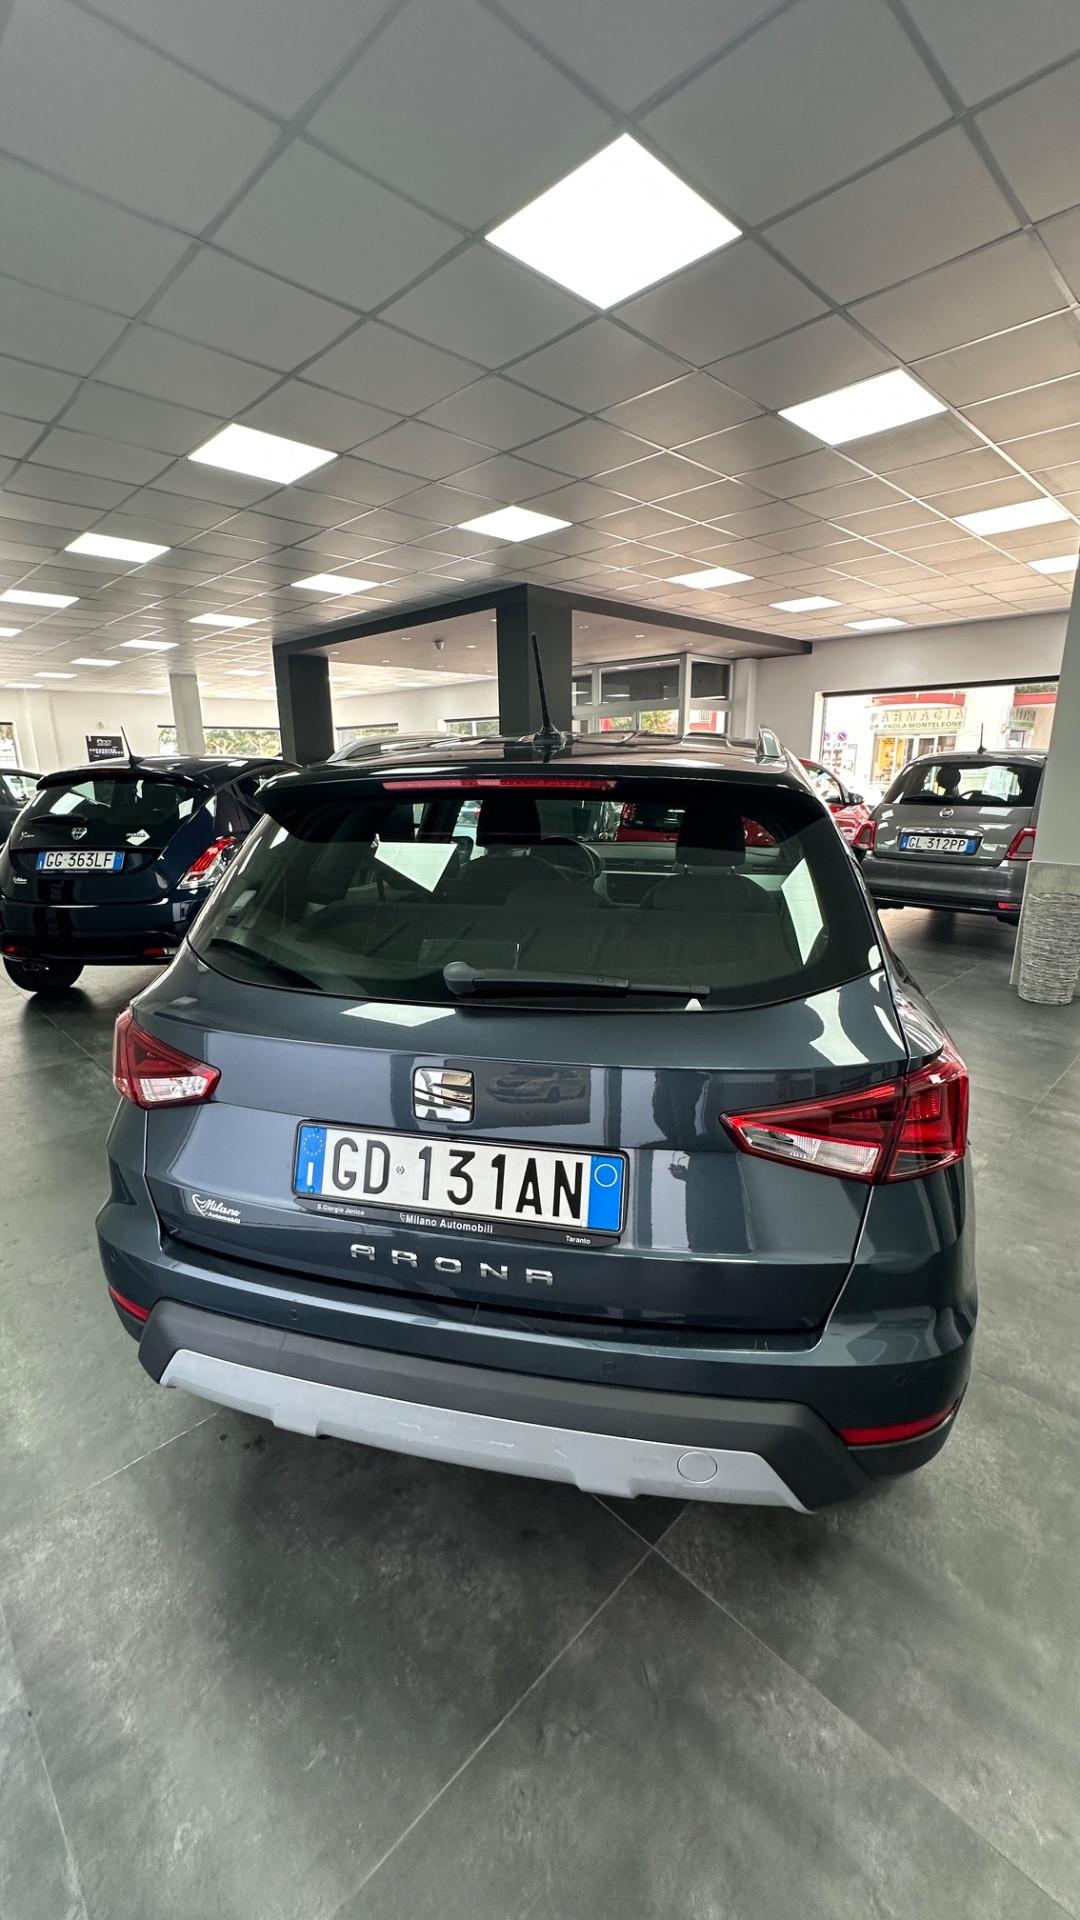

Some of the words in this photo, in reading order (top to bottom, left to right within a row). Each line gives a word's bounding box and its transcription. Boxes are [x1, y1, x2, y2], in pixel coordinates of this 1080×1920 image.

[908, 721, 963, 729] MONTELEONE
[927, 837, 966, 851] 312PP
[46, 853, 62, 867] GG
[68, 853, 113, 867] 363LF
[331, 1137, 391, 1195] GD
[418, 1146, 583, 1219] 131AN
[203, 1199, 241, 1216] Milano
[405, 1214, 437, 1227] Milano
[439, 1218, 493, 1234] Automobili
[565, 1235, 591, 1245] Taranto
[350, 1243, 553, 1286] ARONA
